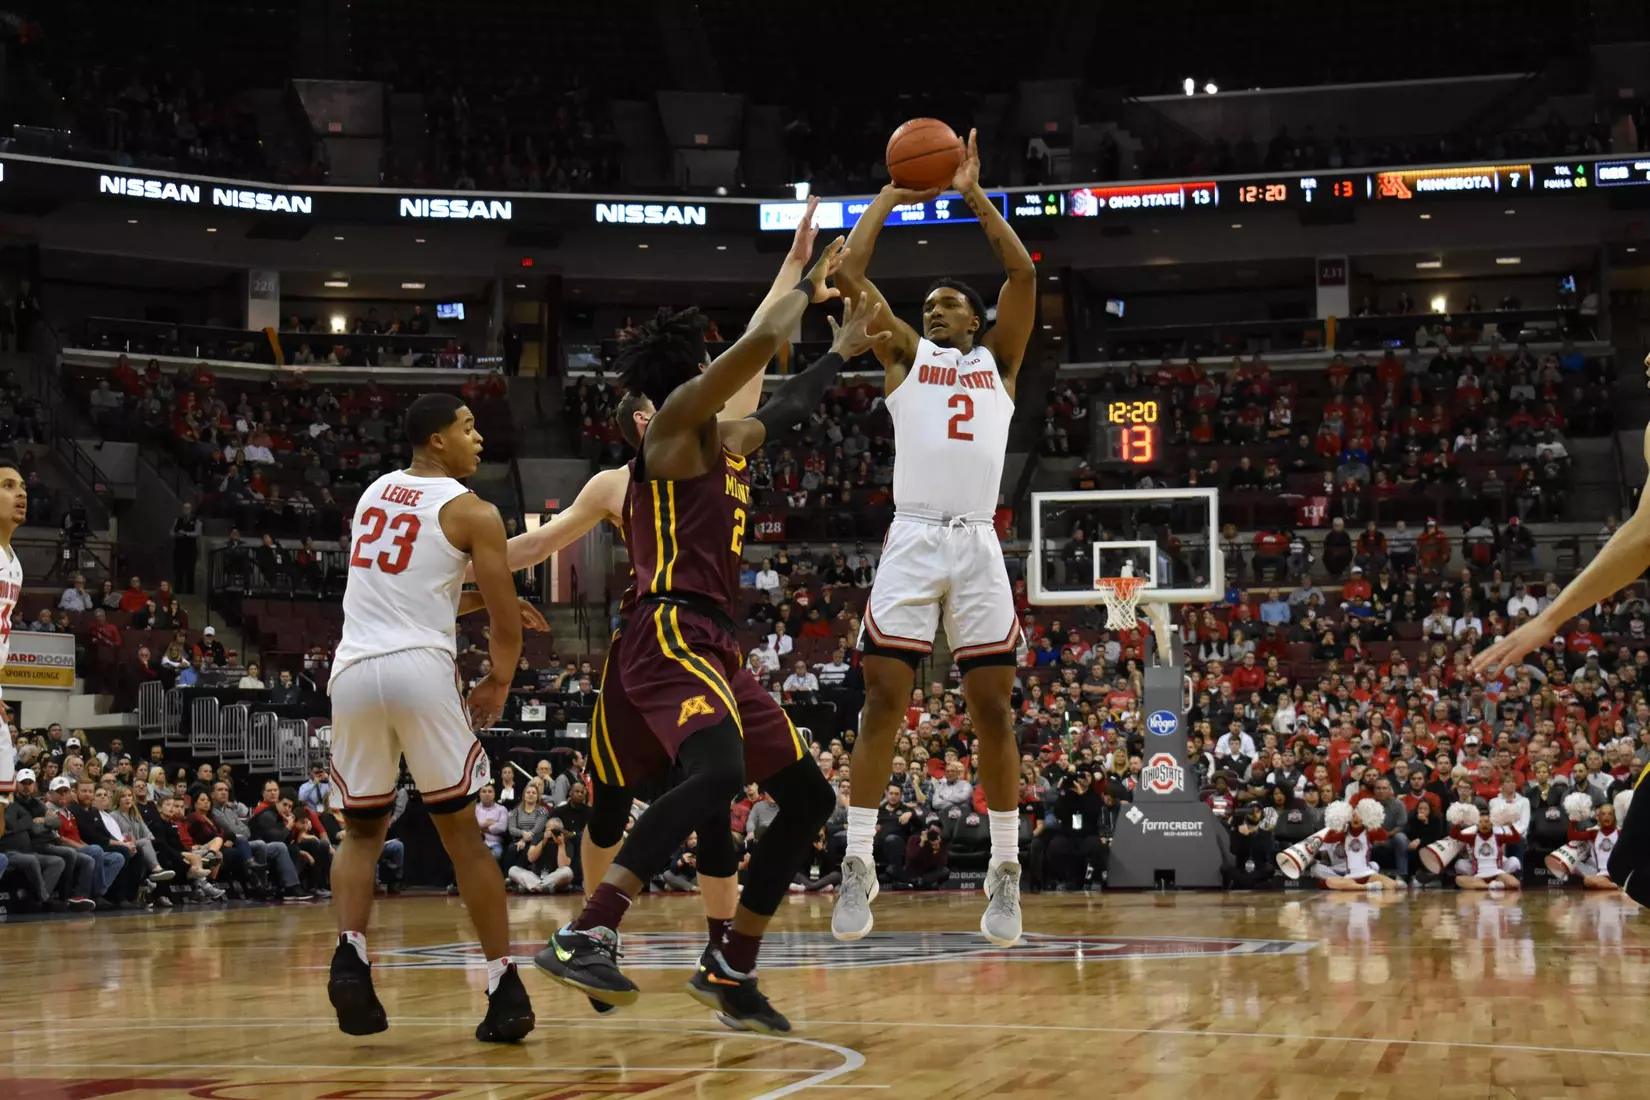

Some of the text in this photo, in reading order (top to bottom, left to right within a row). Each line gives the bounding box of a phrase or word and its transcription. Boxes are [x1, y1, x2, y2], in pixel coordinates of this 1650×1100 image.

[100, 175, 200, 203] NISSAN
[1334, 180, 1353, 197] 13
[1416, 176, 1492, 192] MINNESOTA
[1509, 173, 1520, 188] 7
[1543, 178, 1572, 189] FOULS
[213, 187, 312, 213] NISSAN
[1109, 192, 1181, 209] OHIO STATE
[1192, 189, 1210, 204] 13
[1239, 184, 1287, 202] 12:20
[400, 198, 512, 220] NISSAN
[596, 203, 706, 225] NISSAN
[1015, 206, 1042, 217] FOULS
[919, 364, 995, 389] OHIO STATE
[947, 393, 974, 441] 2
[1109, 401, 1157, 423] 12:20
[1122, 425, 1152, 462] 13
[380, 484, 424, 507] LEDEE
[1302, 505, 1324, 517] 131
[731, 507, 746, 556] 2
[760, 522, 781, 533] 128
[351, 507, 421, 575] 23
[7, 653, 73, 666] ARDROOM
[5, 669, 59, 681] SPORTS LOUNGE
[1149, 713, 1176, 733] Kroger
[1142, 764, 1184, 791] OHIO STATE
